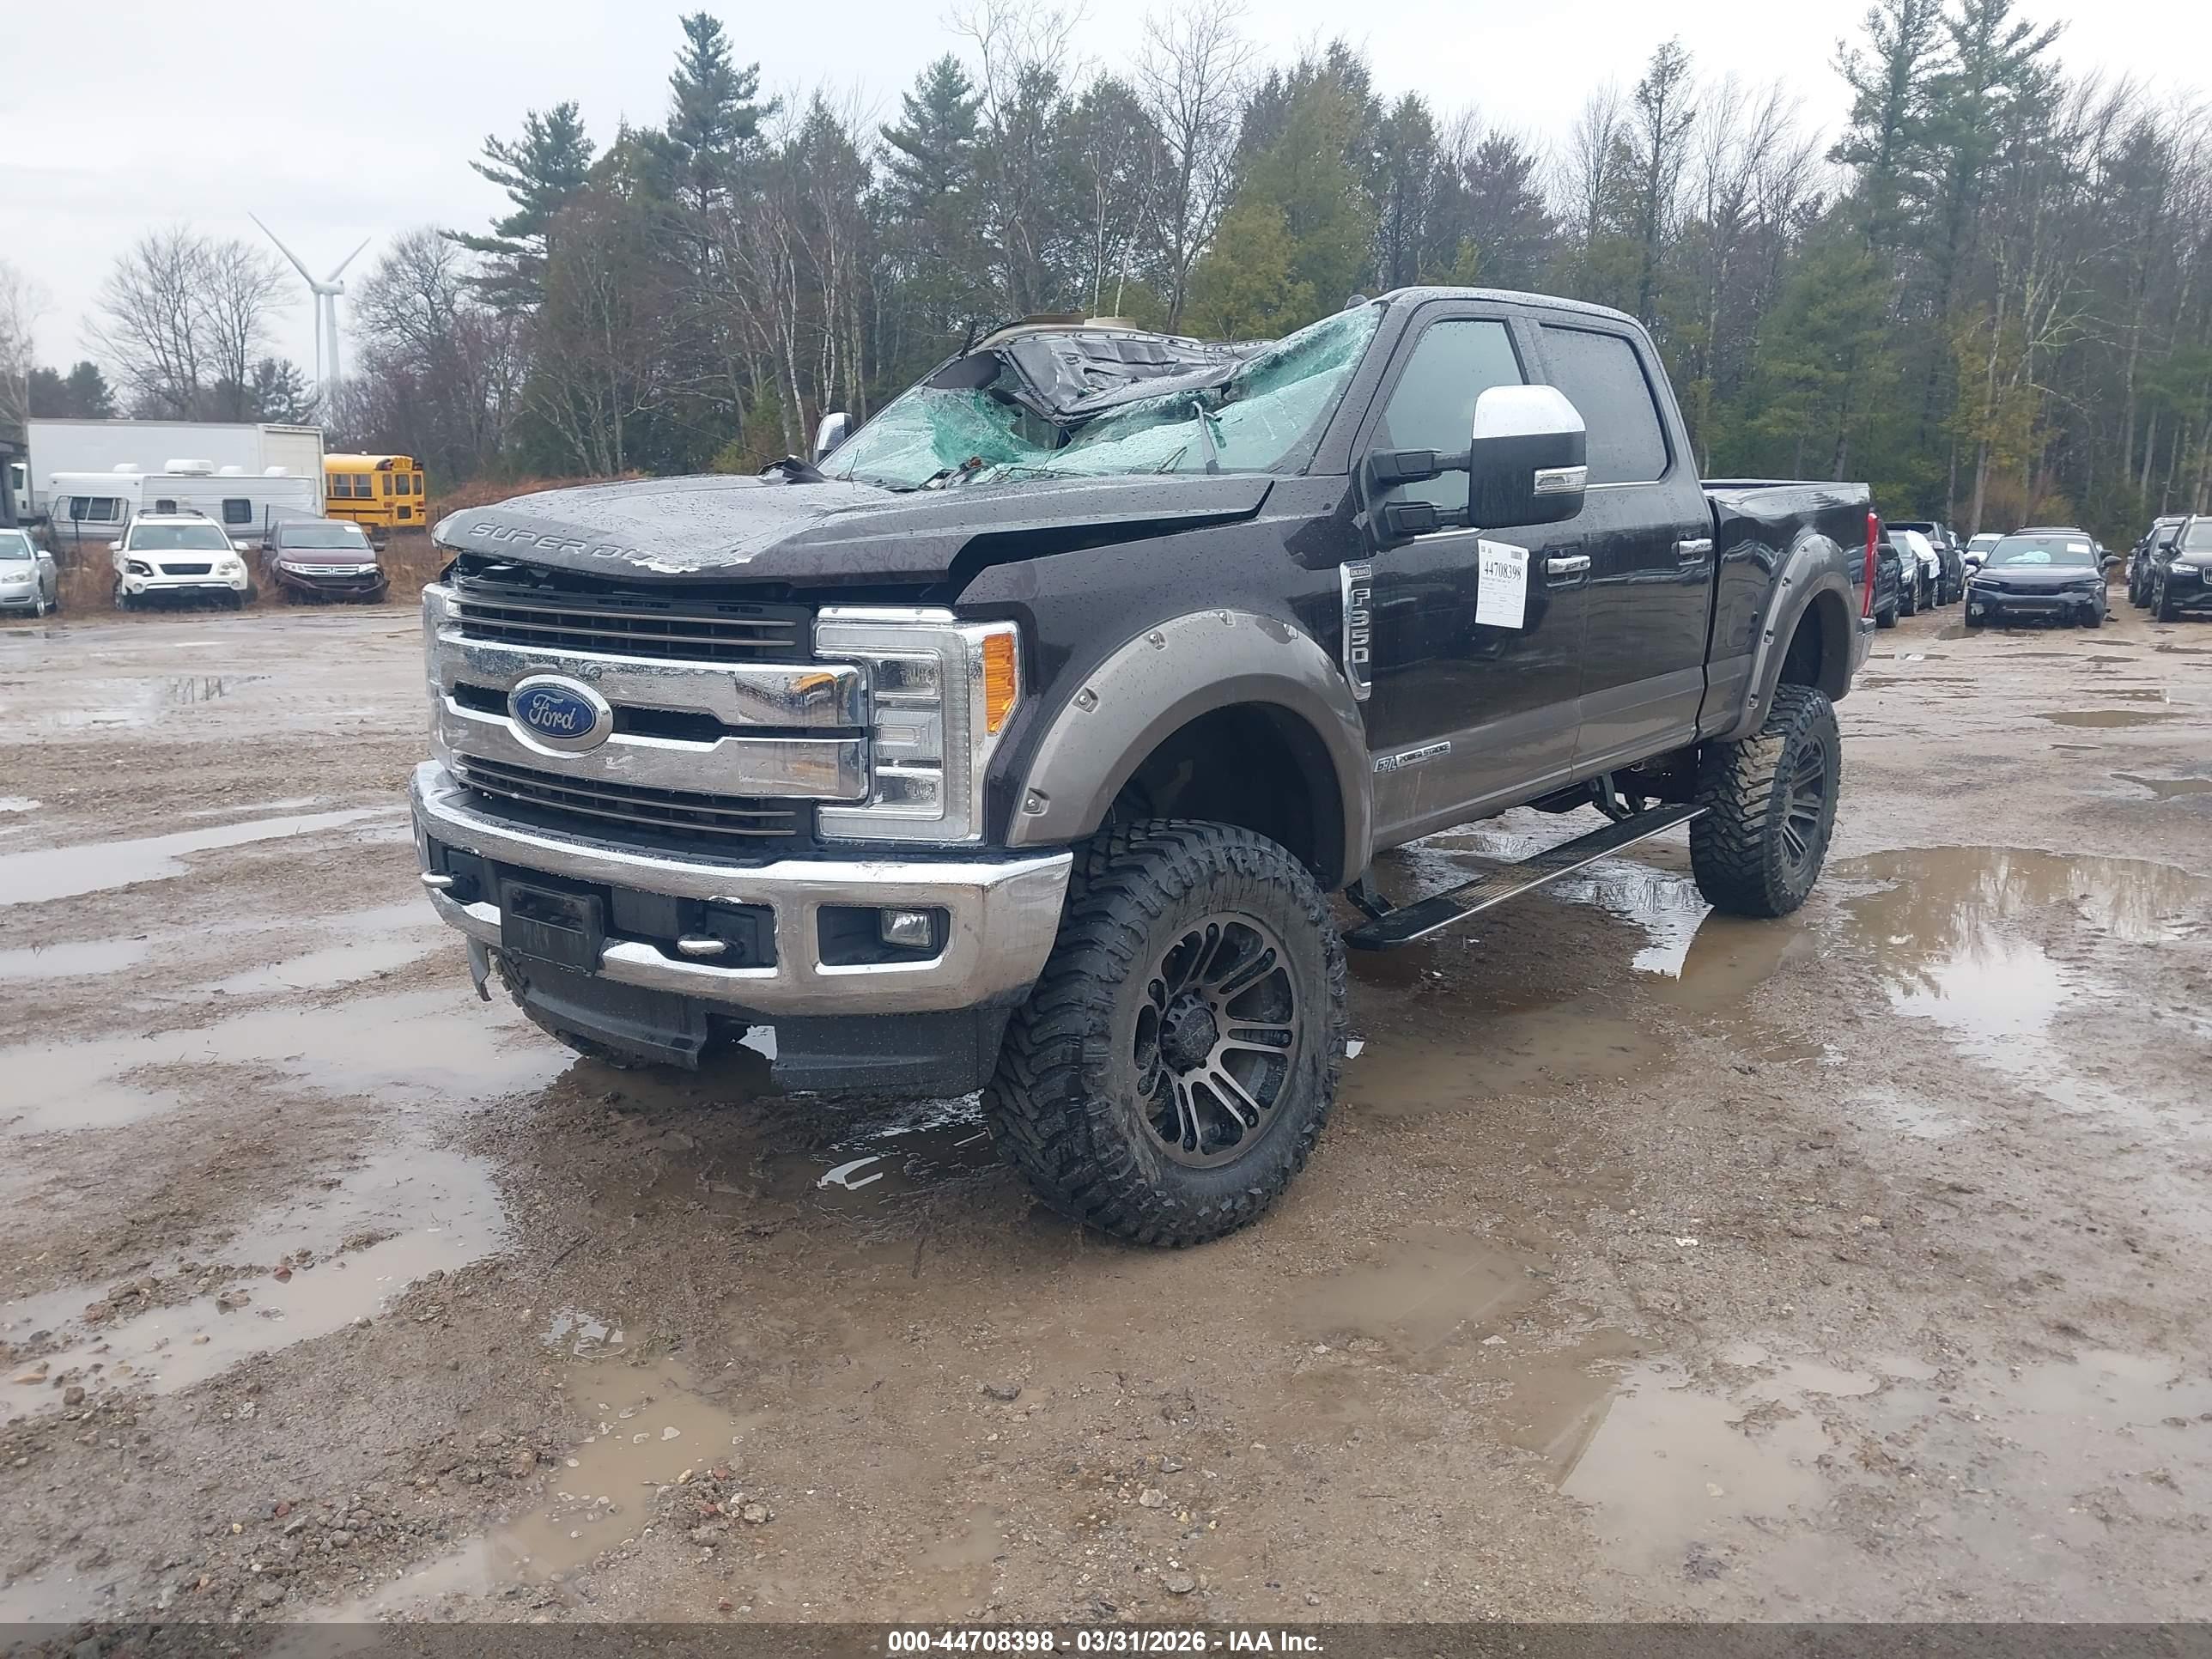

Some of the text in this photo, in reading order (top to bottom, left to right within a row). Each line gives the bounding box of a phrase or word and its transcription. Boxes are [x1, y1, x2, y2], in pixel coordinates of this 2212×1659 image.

[469, 522, 587, 555] SUPER
[1484, 561, 1522, 580] 44708398
[528, 693, 577, 730] Ford
